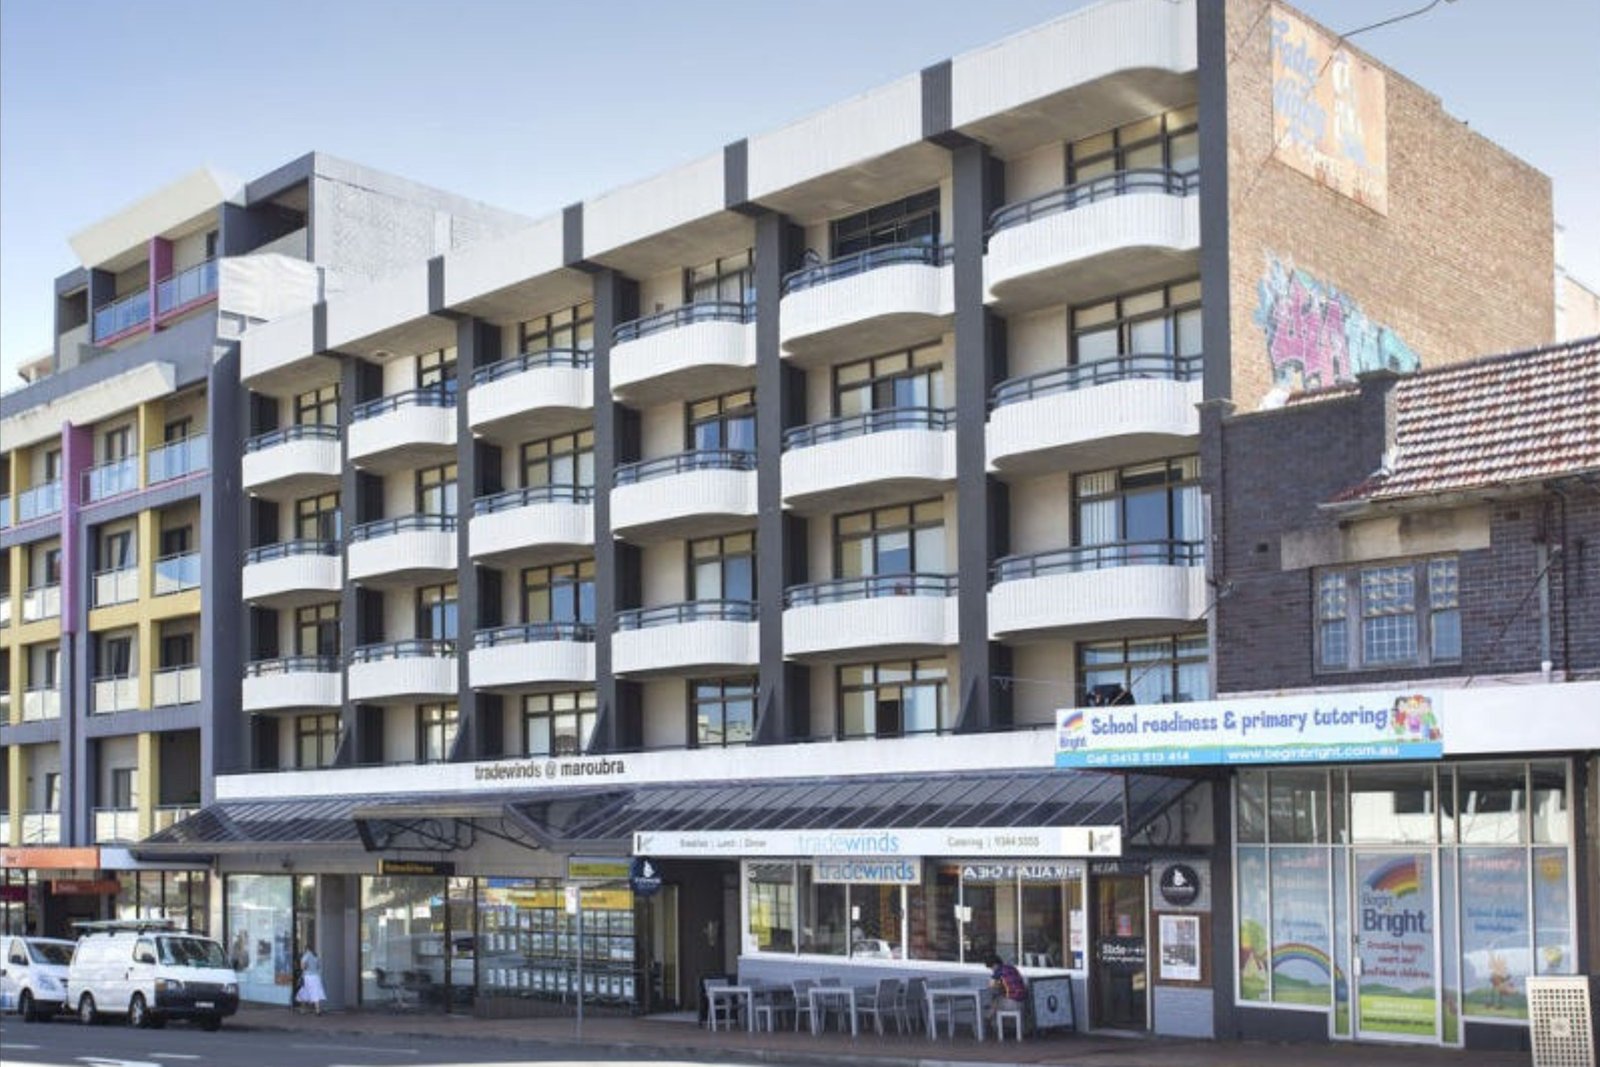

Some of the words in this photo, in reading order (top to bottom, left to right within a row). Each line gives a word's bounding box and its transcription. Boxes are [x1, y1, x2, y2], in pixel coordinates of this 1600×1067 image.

[1092, 712, 1138, 735] School
[1143, 710, 1218, 733] readiness
[1223, 710, 1237, 730] &
[1242, 710, 1308, 736] primary
[1313, 705, 1389, 730] tutoring
[474, 761, 541, 780] tradewinds
[545, 761, 557, 779] @
[561, 758, 625, 777] maroubra
[798, 831, 899, 853] tradewinds
[819, 860, 916, 881] tradewinds
